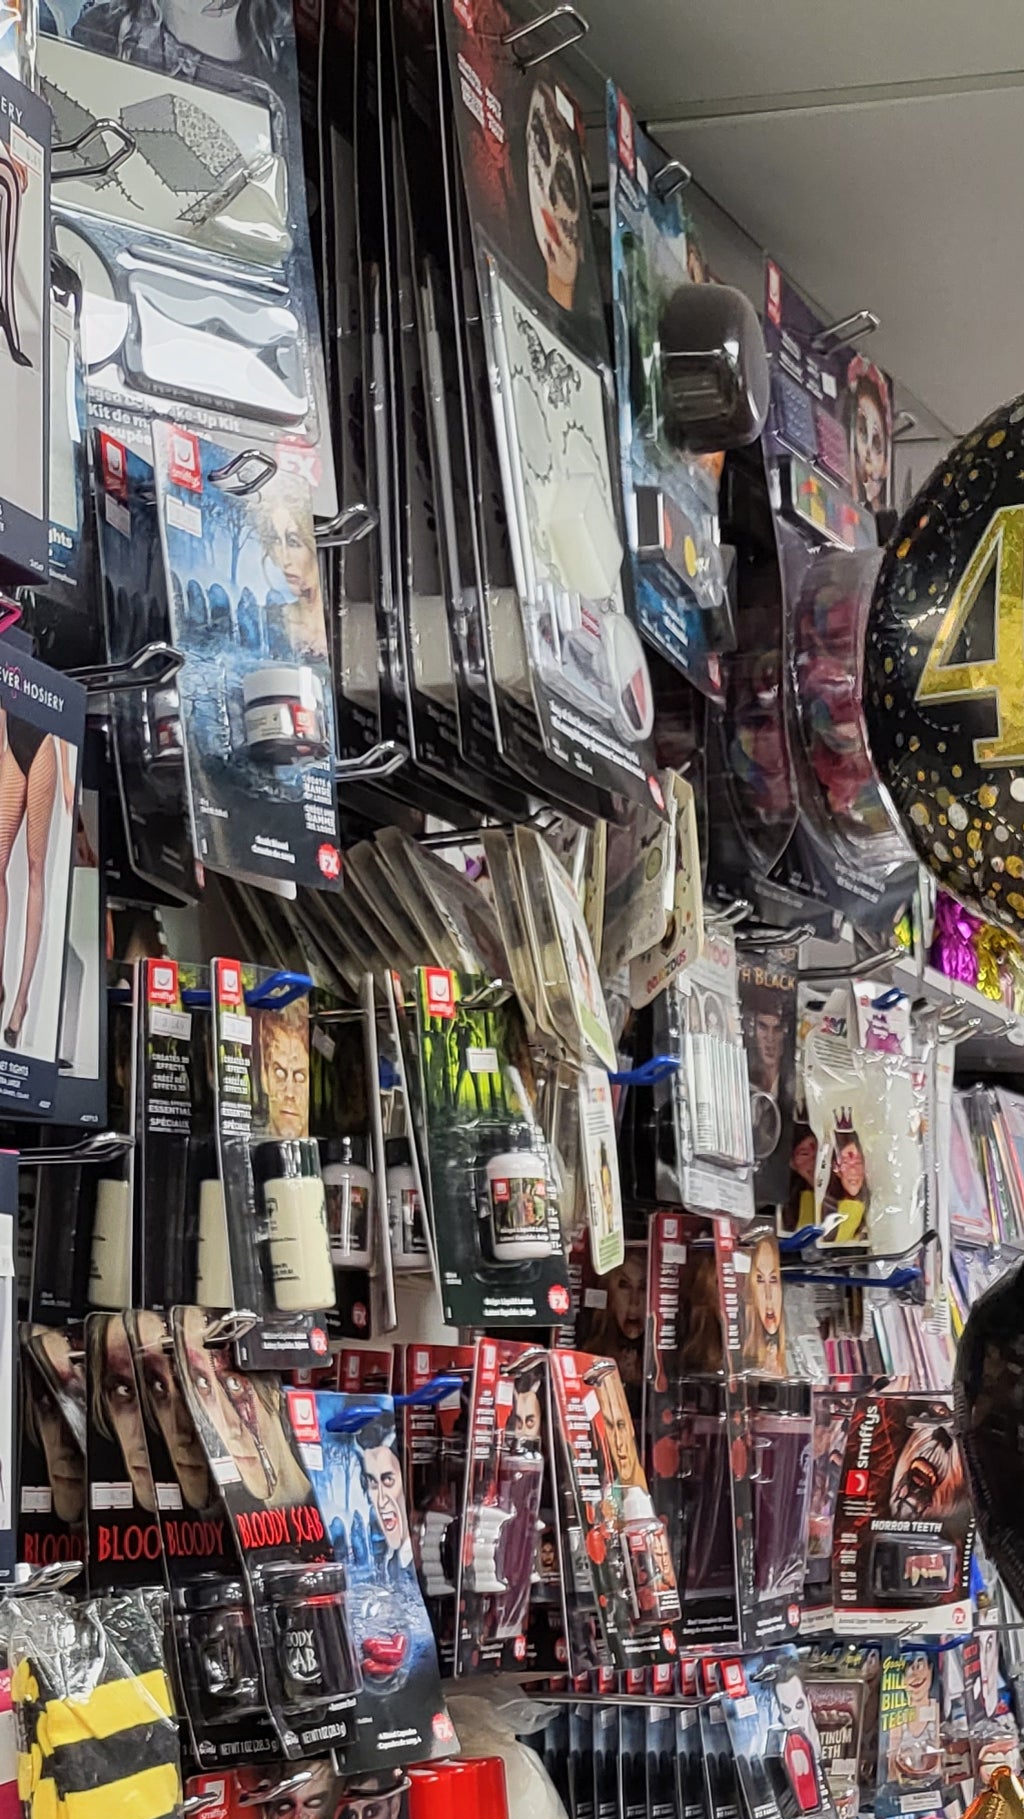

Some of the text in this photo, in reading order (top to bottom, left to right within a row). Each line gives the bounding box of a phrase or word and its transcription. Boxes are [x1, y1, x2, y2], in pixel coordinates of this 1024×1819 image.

[87, 403, 111, 420] Kit
[112, 408, 131, 424] de
[217, 418, 241, 433] Kit
[0, 668, 65, 713] EVER HOSIERY
[755, 966, 796, 990] BLACK
[857, 1405, 881, 1470] smiffys
[235, 1505, 325, 1550] BLOODY SCAB
[871, 1519, 943, 1533] HORROR TEETH
[25, 1532, 84, 1564] BLOOD
[98, 1526, 160, 1562] BLOO
[166, 1521, 225, 1557] BLOODY
[286, 1629, 314, 1648] OODY
[883, 1672, 907, 1691] HILL
[881, 1692, 913, 1711] BILLY
[881, 1710, 917, 1732] TEETH
[820, 1729, 852, 1745] TINUM
[821, 1745, 841, 1759] ETH
